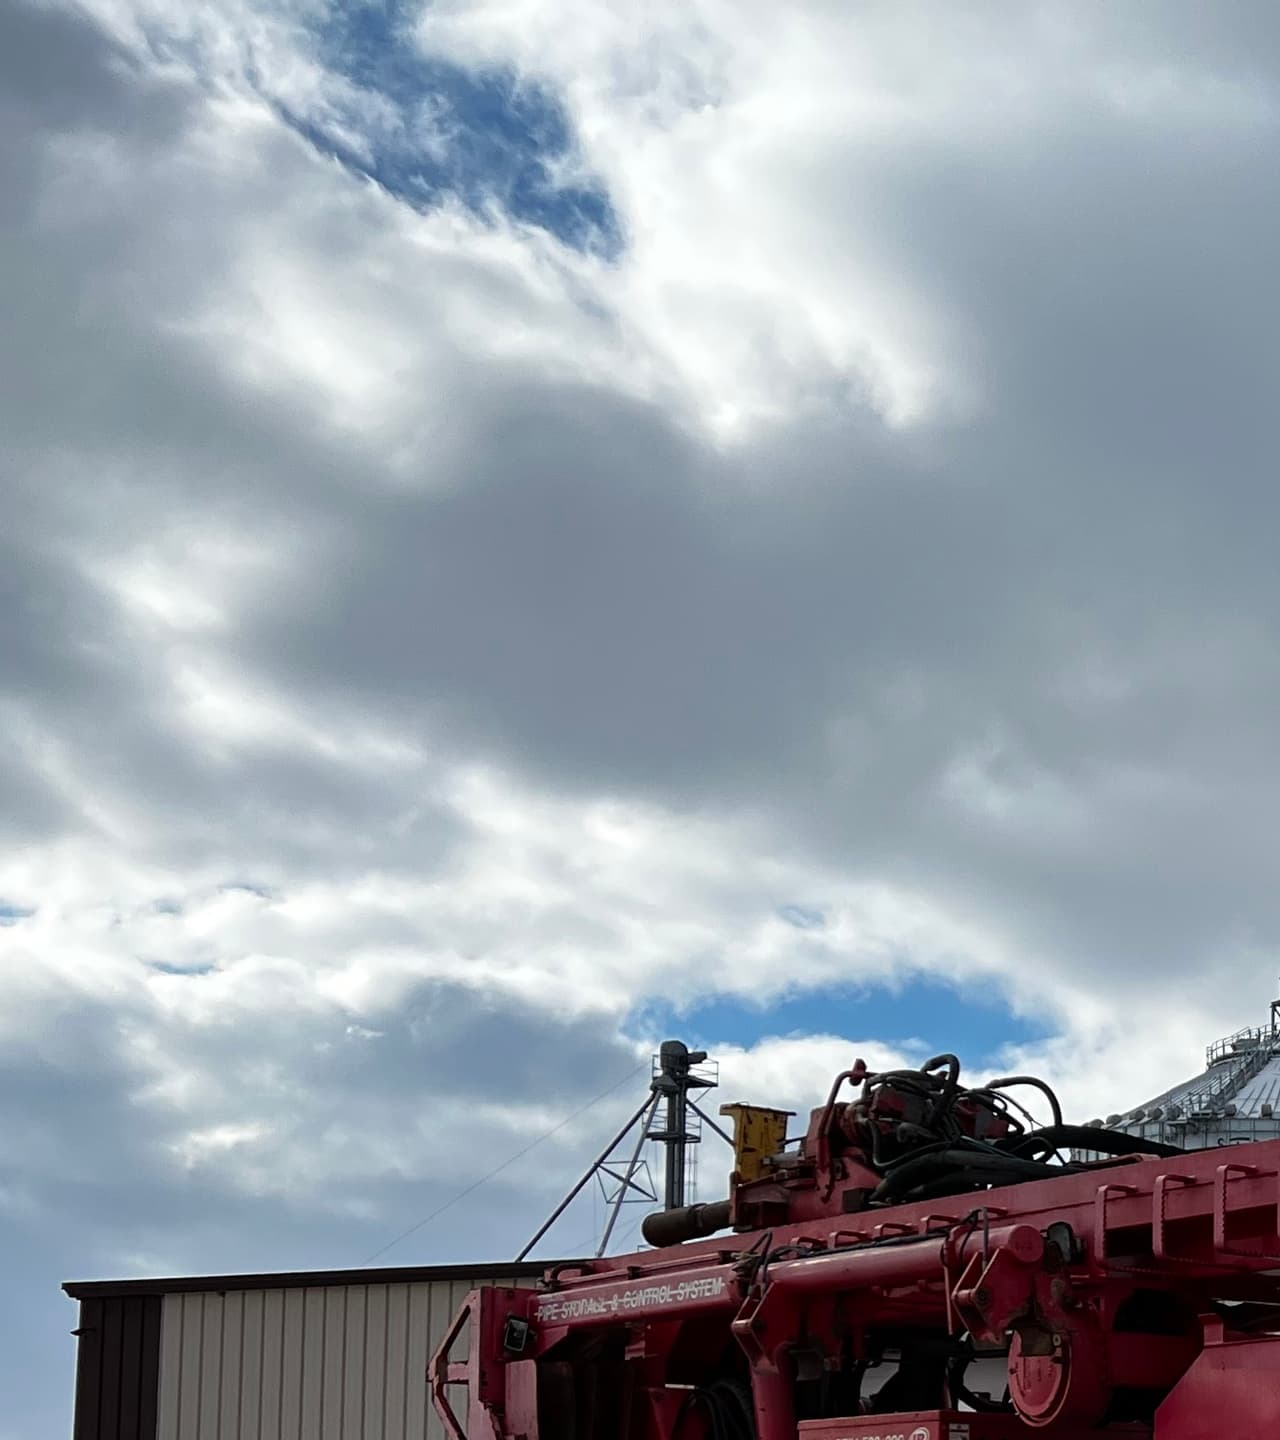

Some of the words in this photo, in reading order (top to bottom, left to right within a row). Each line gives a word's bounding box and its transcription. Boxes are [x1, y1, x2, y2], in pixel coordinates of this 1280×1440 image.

[537, 1303, 558, 1322] PIPE
[611, 1294, 619, 1311] &
[623, 1286, 673, 1308] CONTROL
[677, 1277, 723, 1300] SYSTEM
